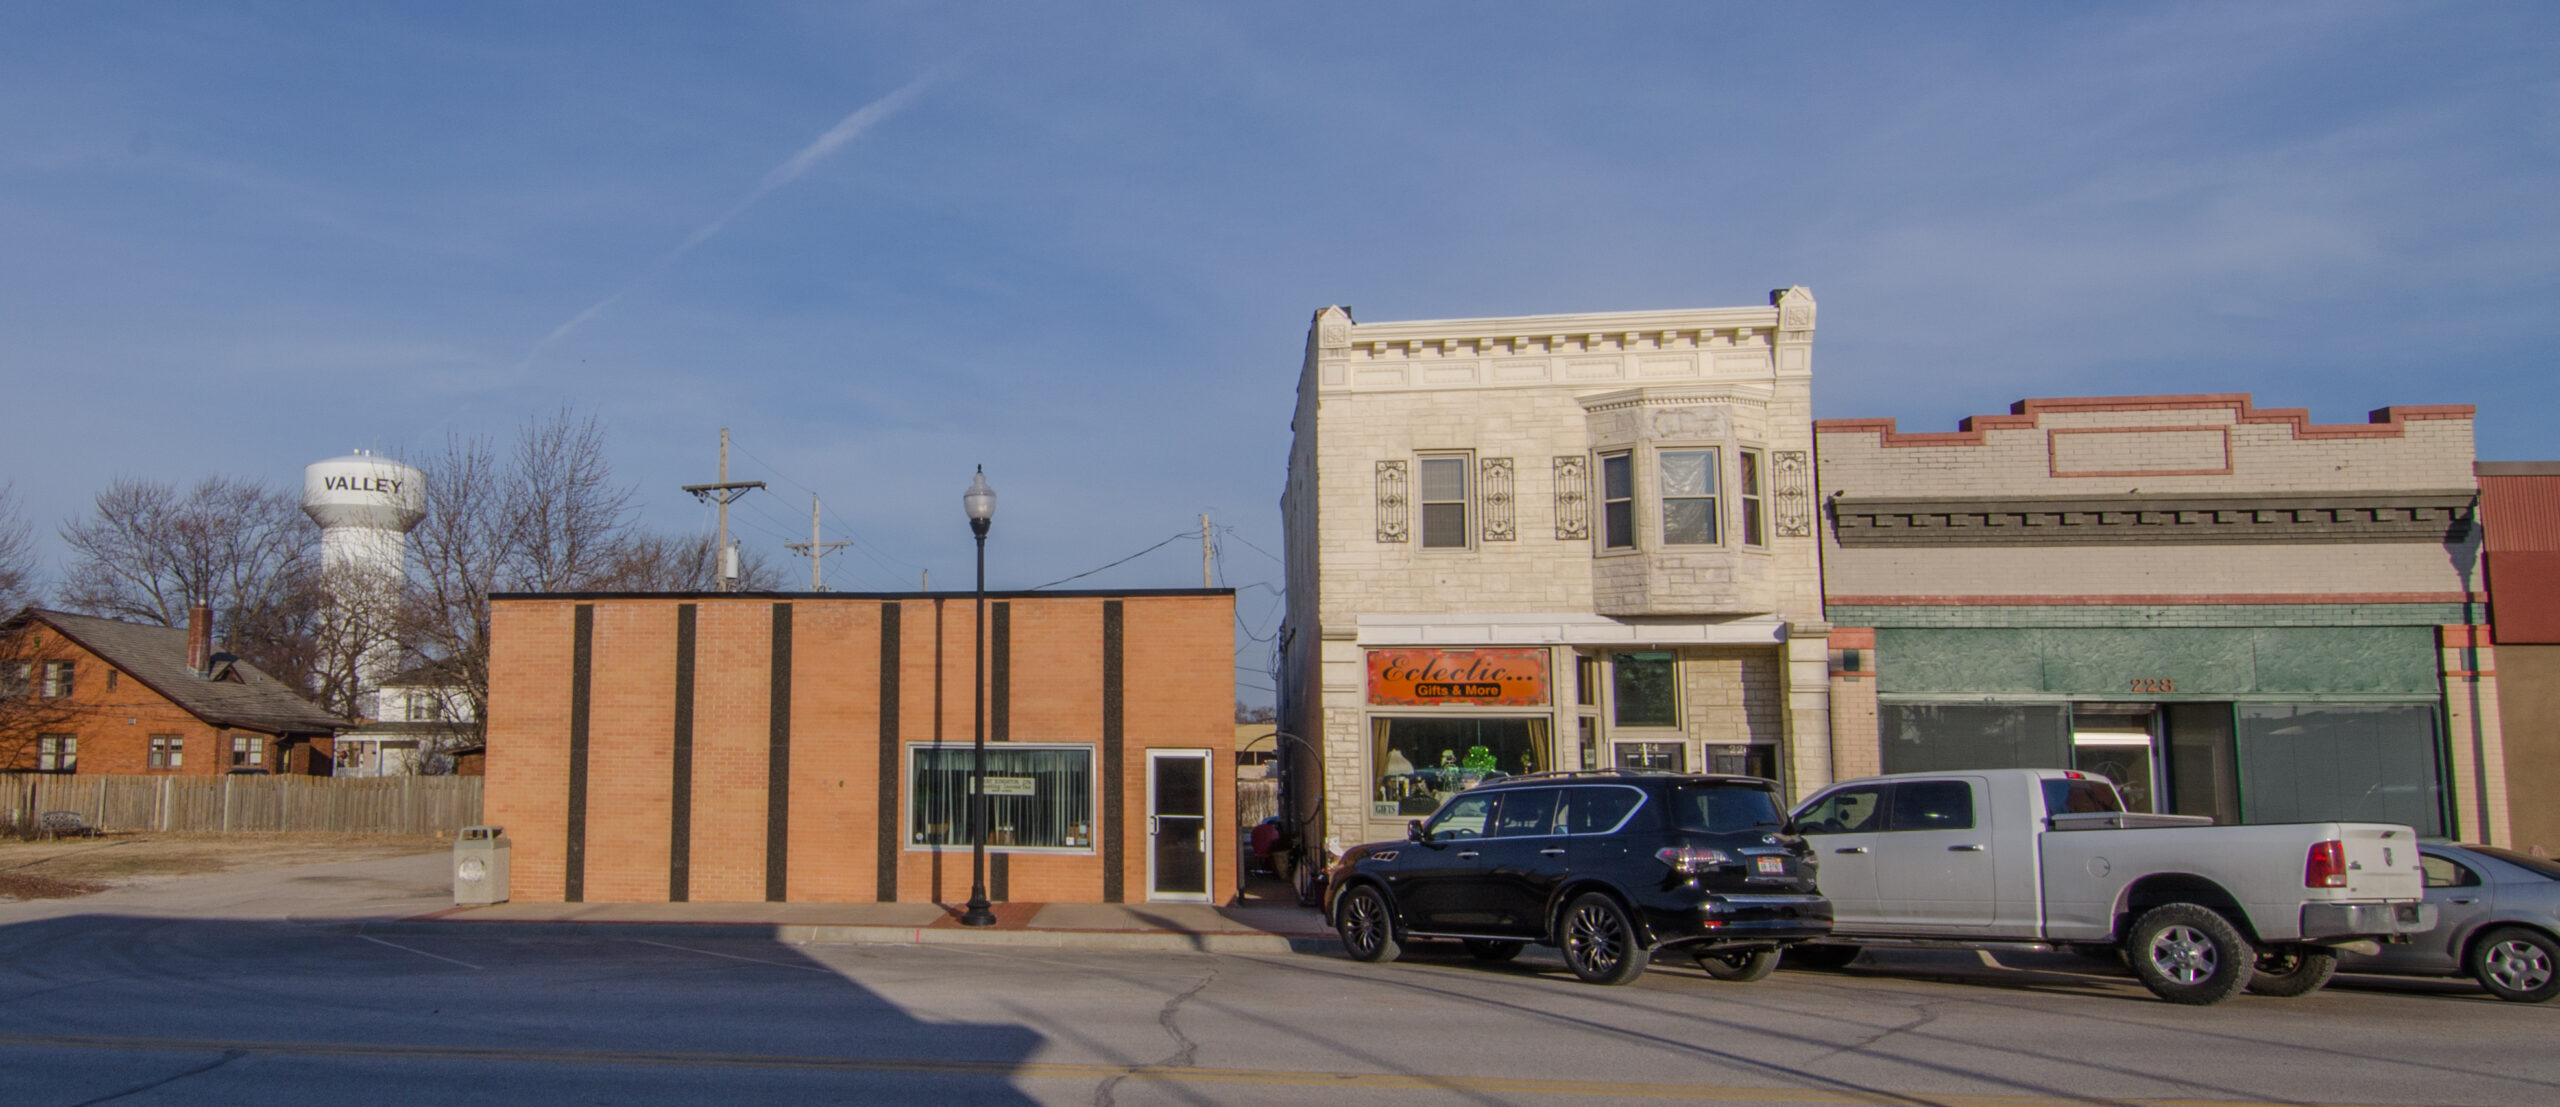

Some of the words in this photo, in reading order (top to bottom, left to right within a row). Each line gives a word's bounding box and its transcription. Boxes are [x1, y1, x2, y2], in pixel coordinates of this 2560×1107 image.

[324, 476, 402, 494] VALLEY
[1382, 656, 1533, 681] Eclectic...
[1417, 685, 1449, 696] Gifts
[1452, 685, 1462, 696] &
[1465, 685, 1499, 696] More
[2130, 678, 2175, 693] 228
[1375, 804, 1396, 814] GIFTS
